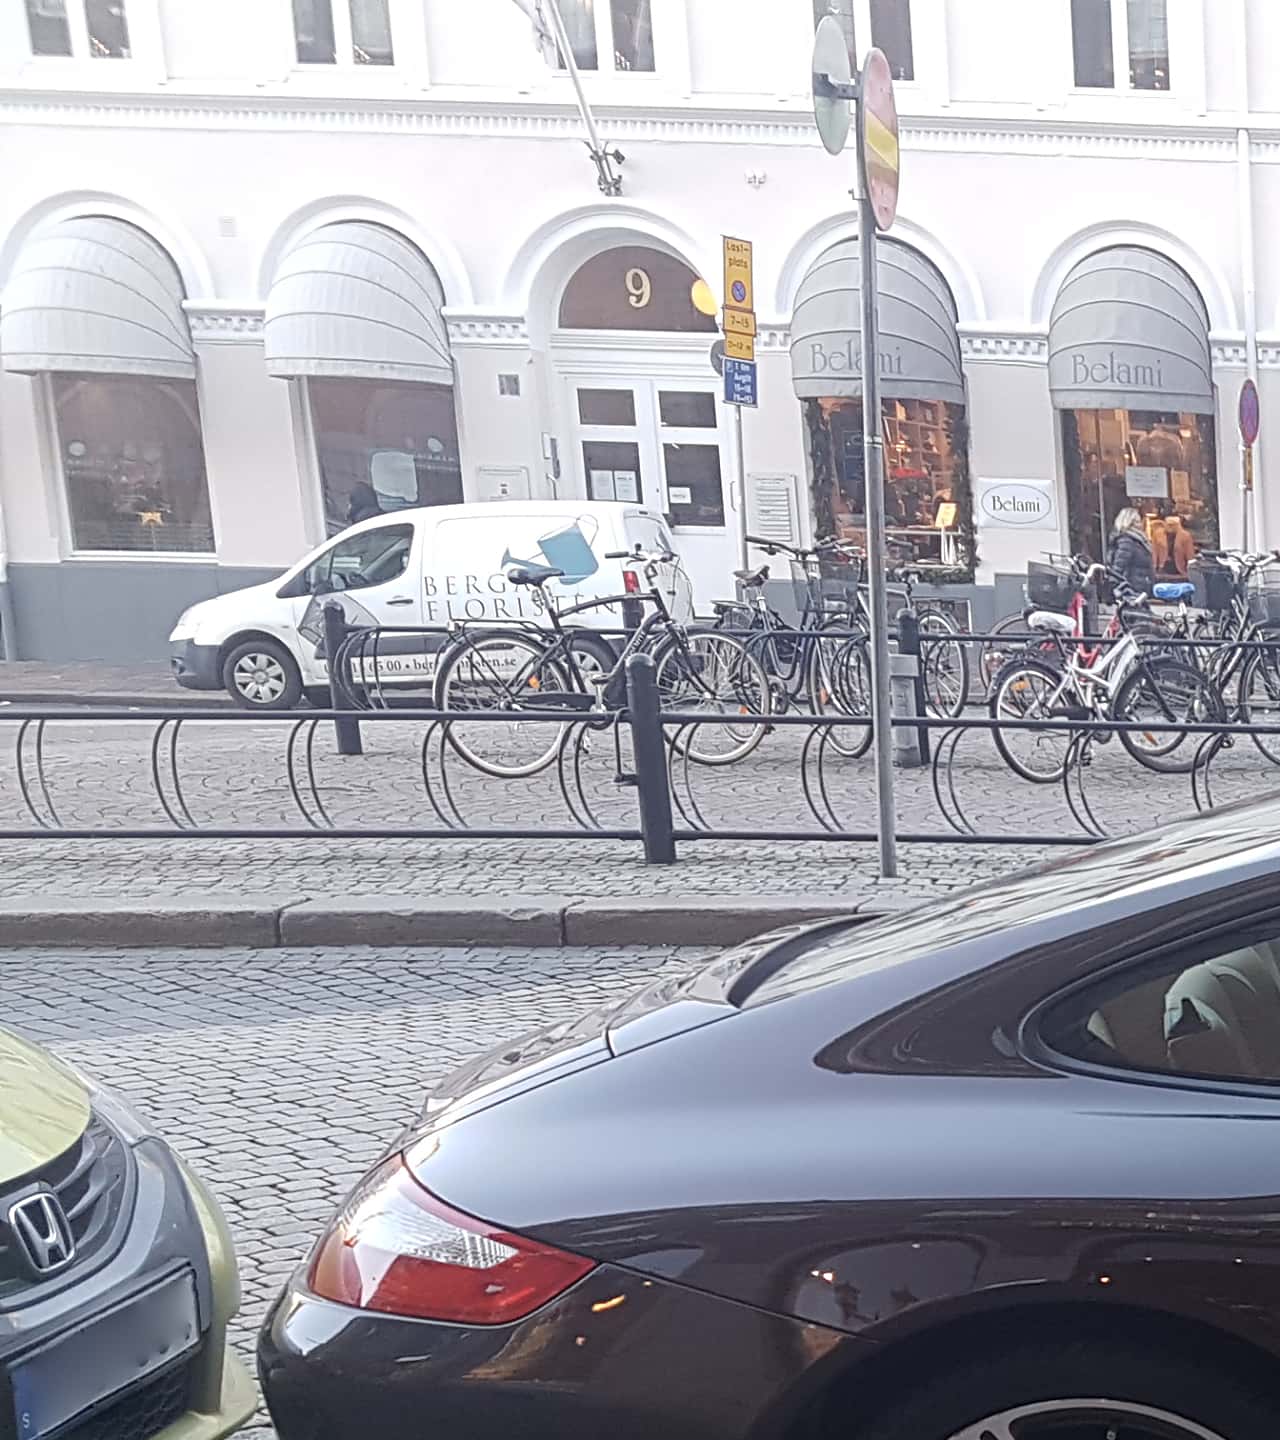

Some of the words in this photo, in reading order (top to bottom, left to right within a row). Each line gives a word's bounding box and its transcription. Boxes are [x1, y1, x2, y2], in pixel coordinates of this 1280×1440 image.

[625, 268, 651, 308] 9
[810, 340, 903, 375] Belami
[1070, 351, 1164, 387] Belami
[991, 494, 1041, 513] Belami
[22, 1411, 30, 1429] S
